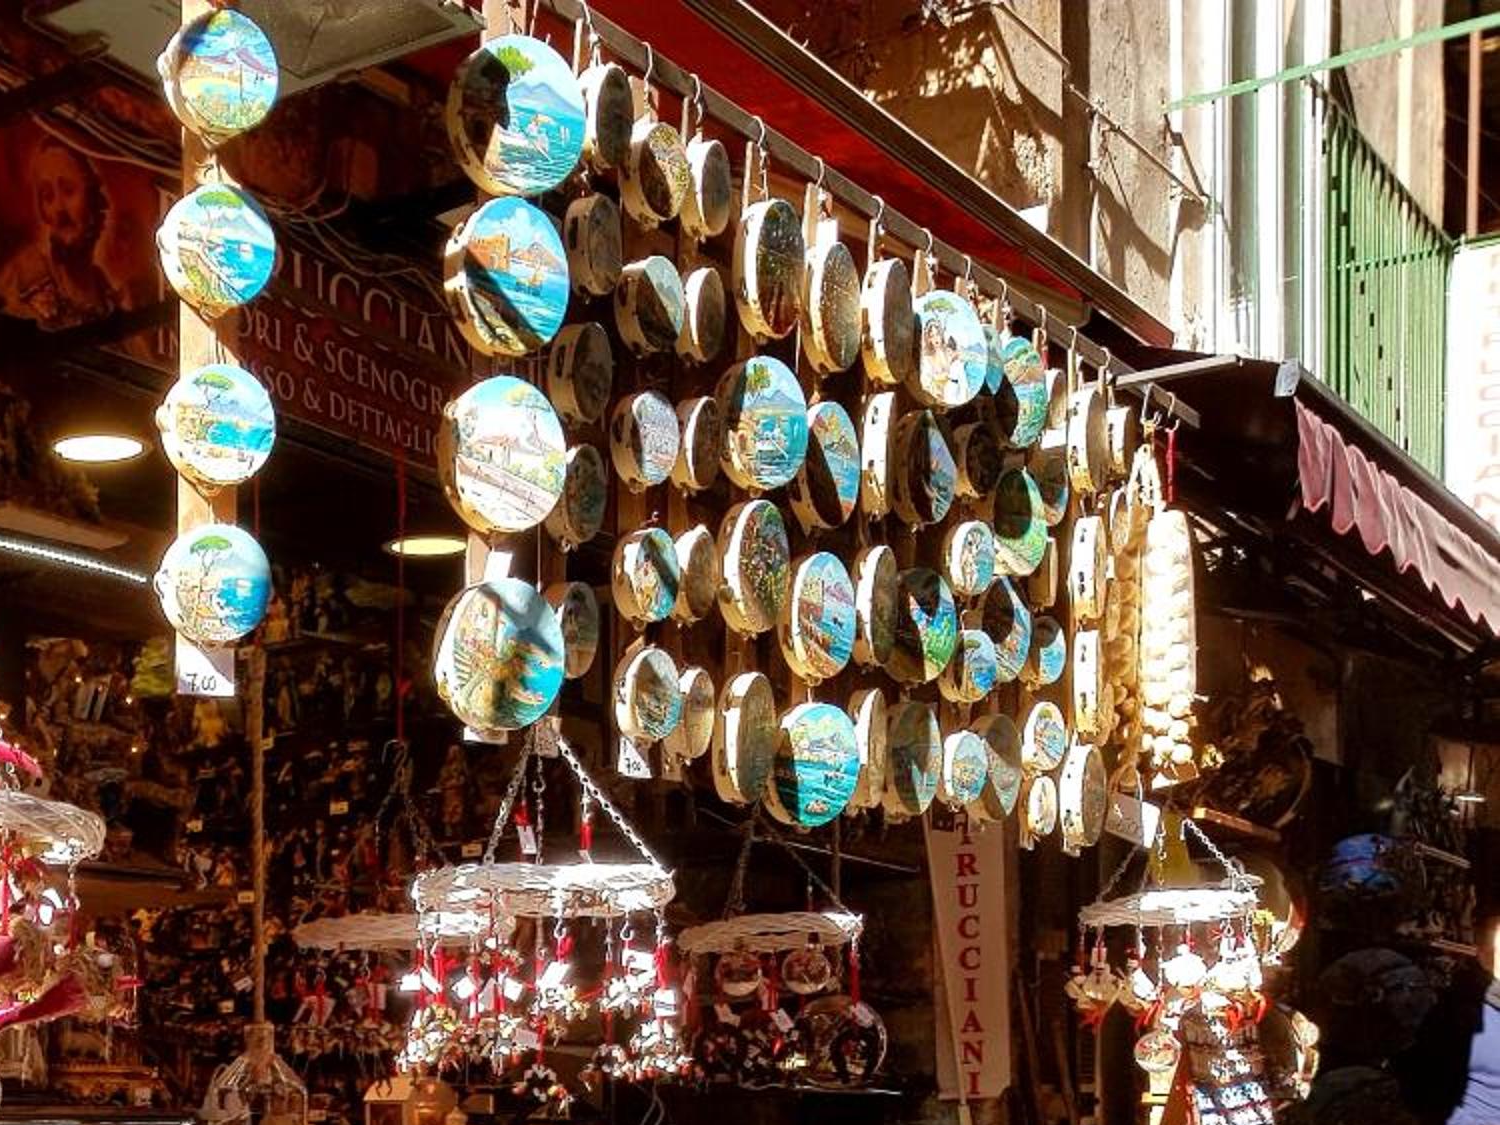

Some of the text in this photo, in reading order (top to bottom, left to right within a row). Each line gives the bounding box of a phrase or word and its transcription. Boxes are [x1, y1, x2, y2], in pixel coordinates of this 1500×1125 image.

[294, 322, 318, 367] &
[323, 340, 444, 416] SCENOGR
[302, 375, 325, 413] &
